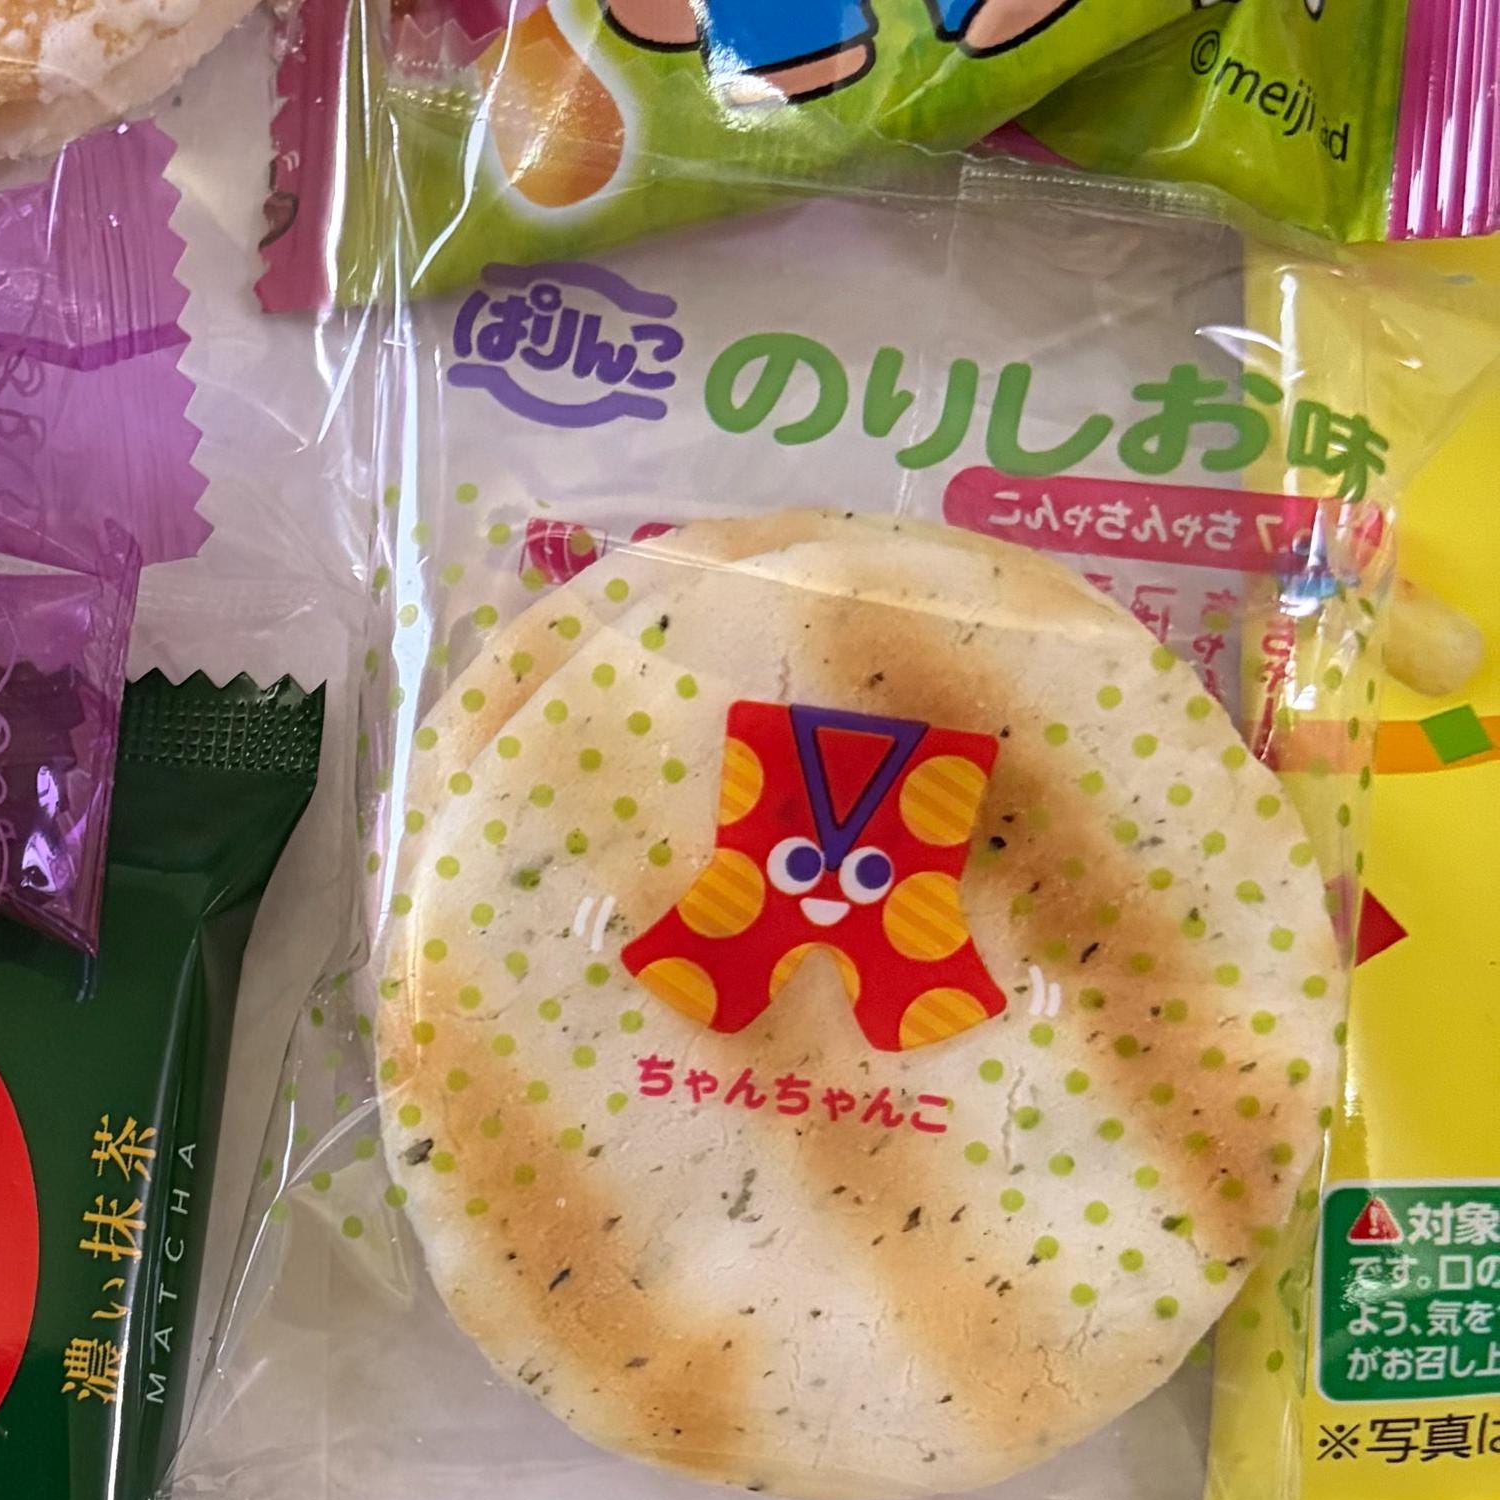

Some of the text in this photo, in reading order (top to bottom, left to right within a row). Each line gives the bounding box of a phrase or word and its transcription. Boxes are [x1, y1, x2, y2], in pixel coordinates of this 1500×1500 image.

[452, 284, 684, 390] ぱりんこ
[704, 331, 1389, 501] のりしお味
[637, 1054, 949, 1134] ちゃんちゃんこ
[60, 1114, 158, 1405] 濃い抹茶
[145, 1142, 198, 1405] MATCHA
[1347, 1300, 1500, 1337] よう、気を
